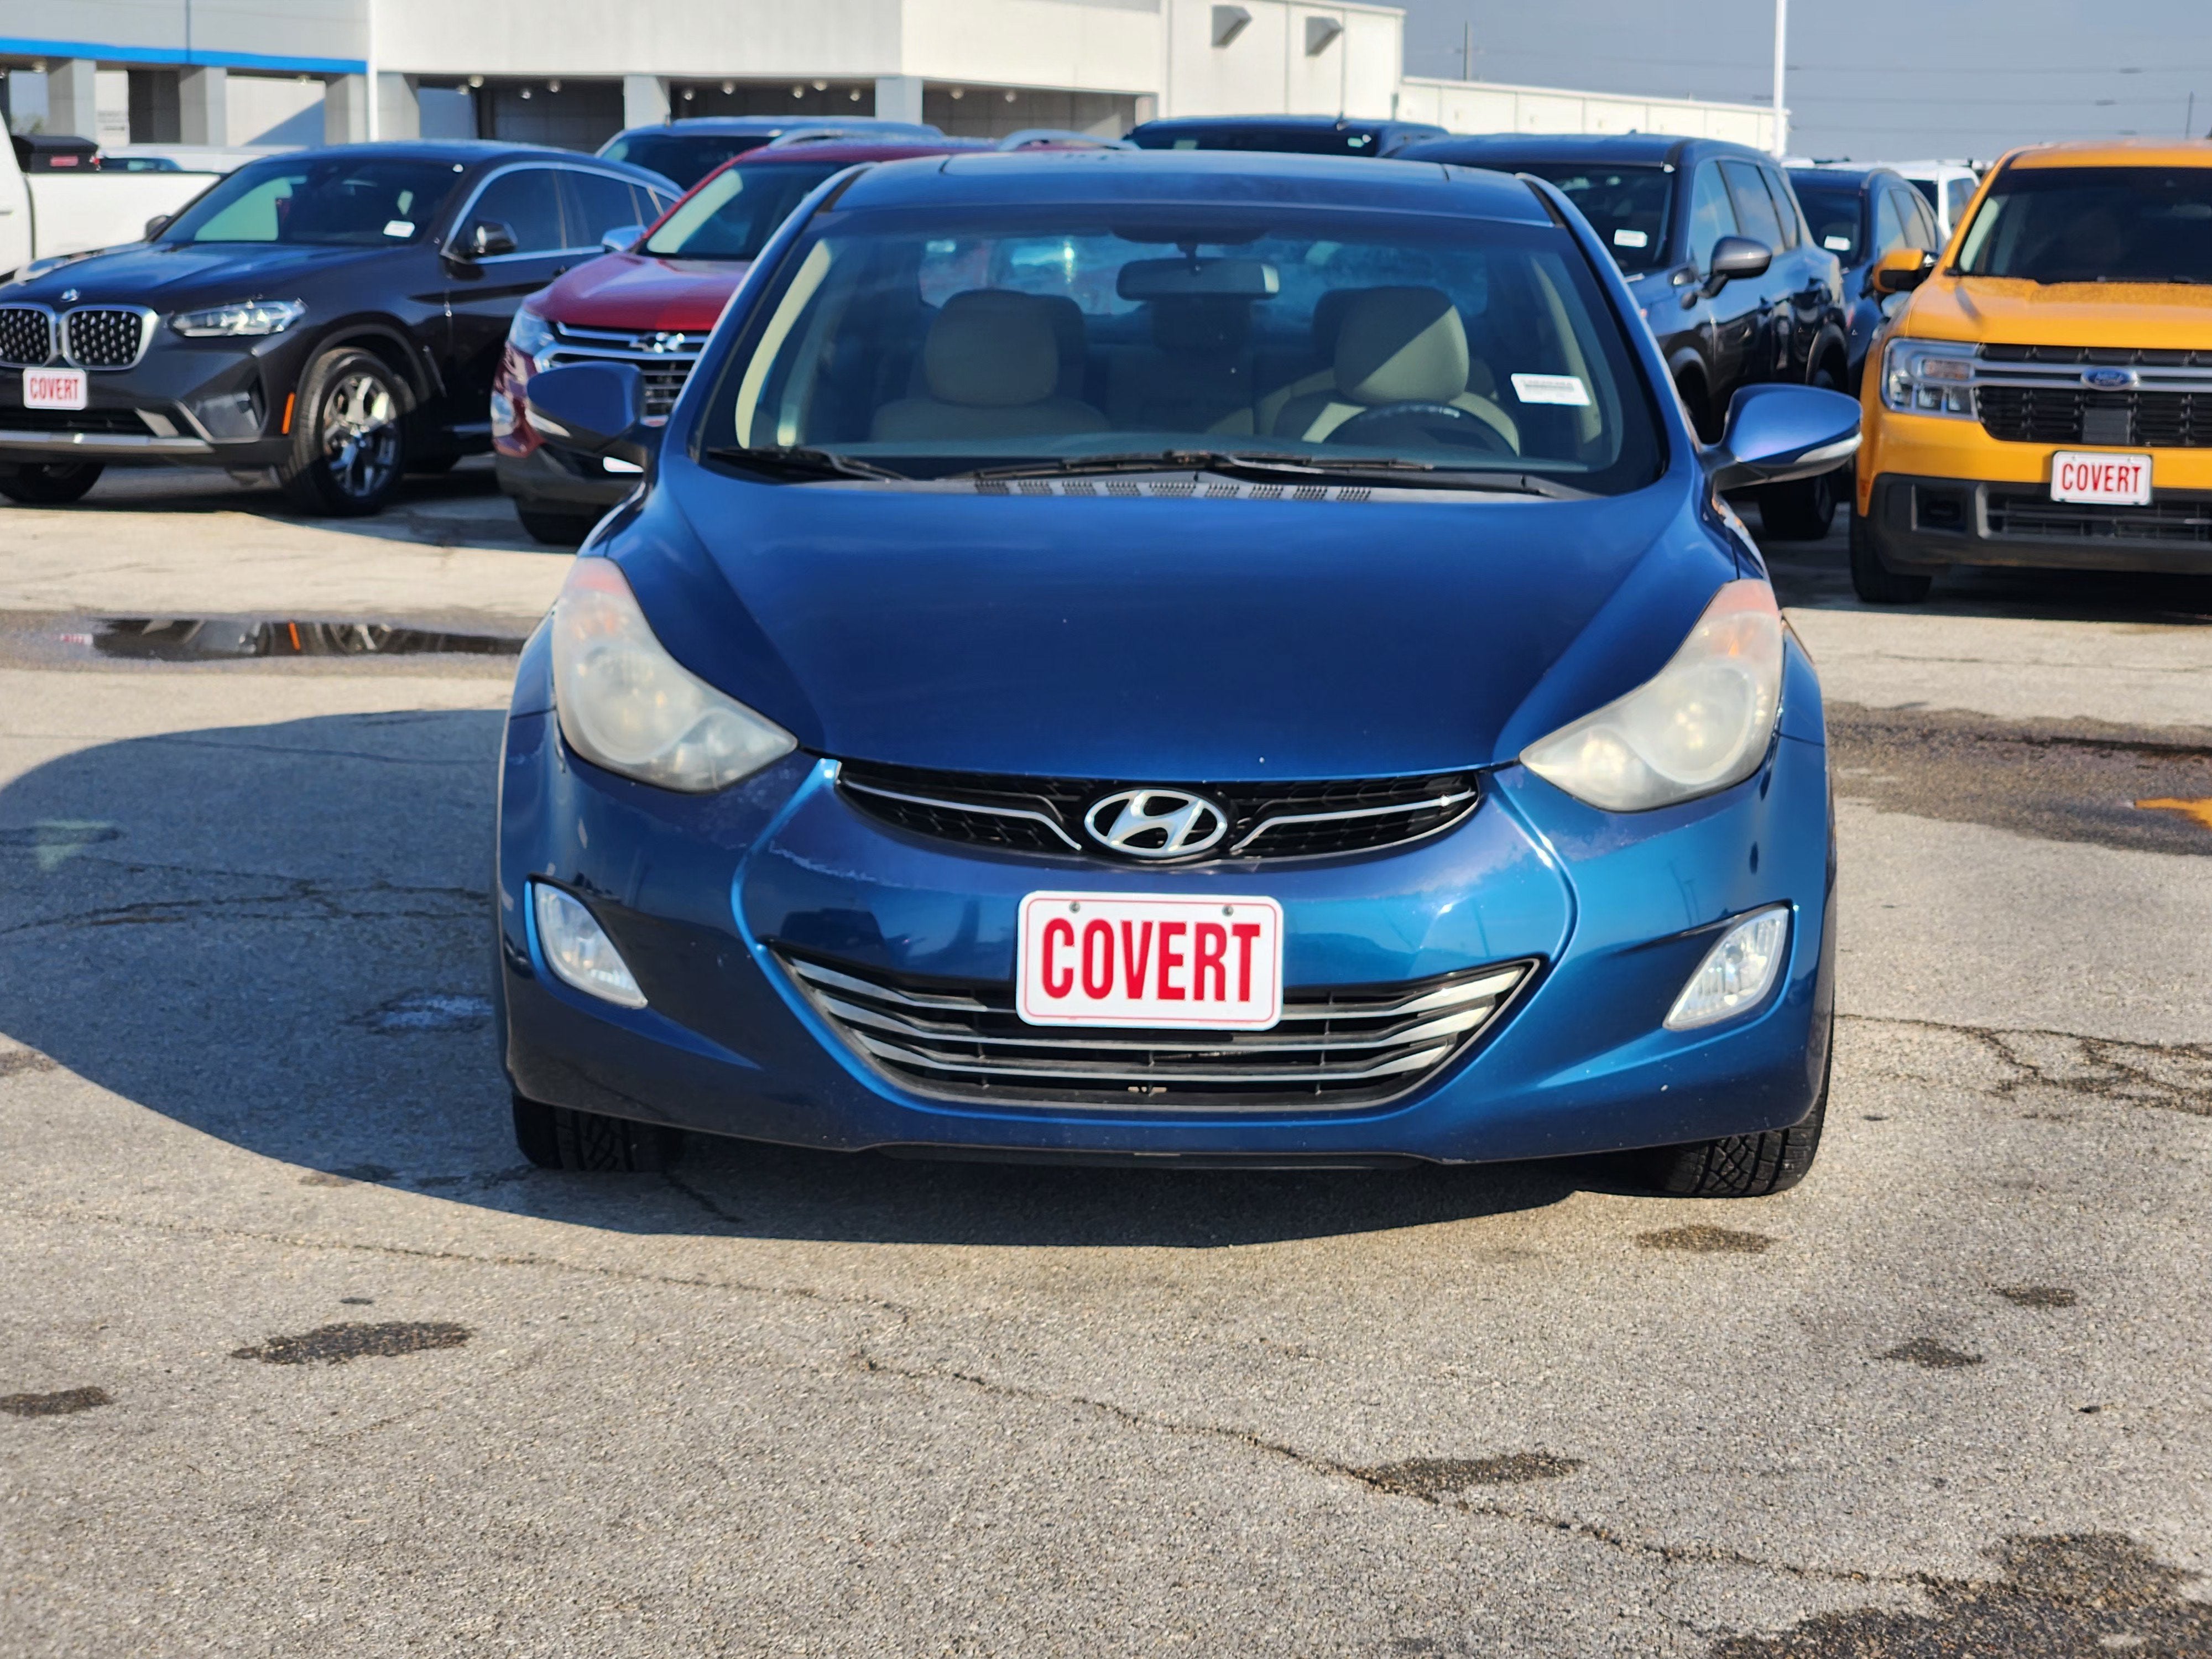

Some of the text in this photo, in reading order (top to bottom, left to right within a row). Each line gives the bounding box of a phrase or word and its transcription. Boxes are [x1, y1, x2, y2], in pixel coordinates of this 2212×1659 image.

[30, 377, 79, 399] COVERT
[2062, 463, 2141, 493] COVERT
[1042, 917, 1261, 1002] COVERT
